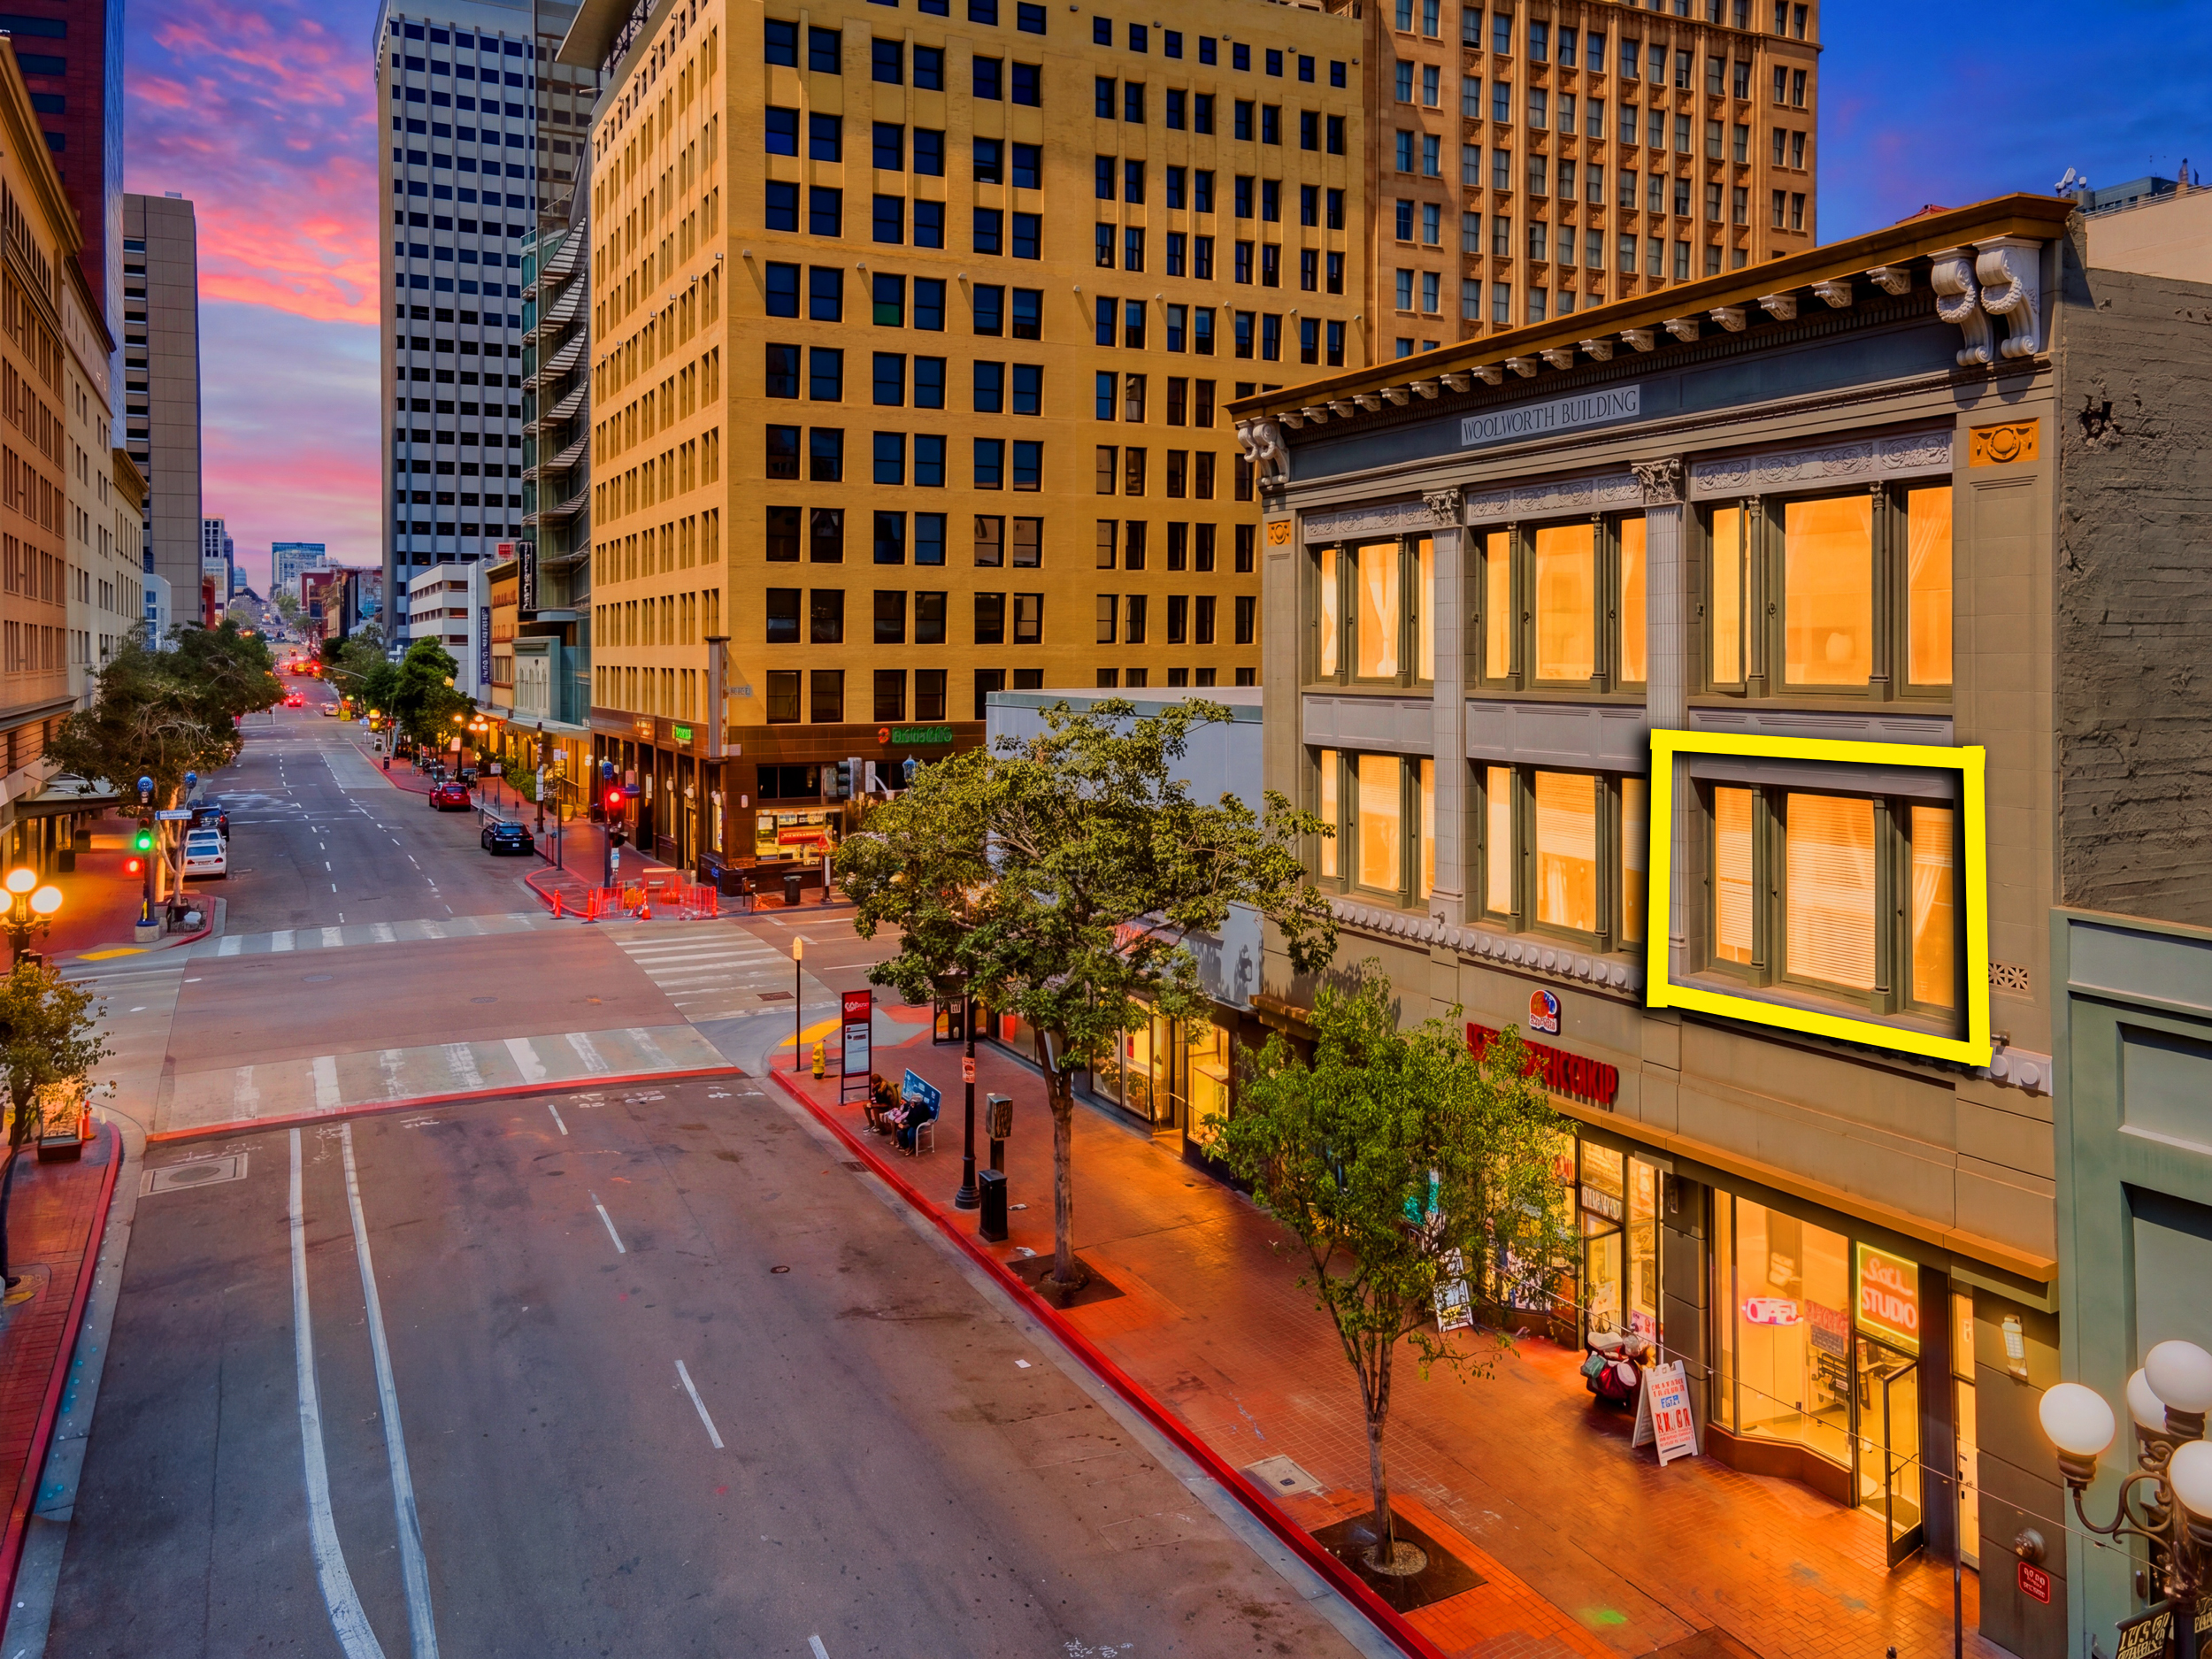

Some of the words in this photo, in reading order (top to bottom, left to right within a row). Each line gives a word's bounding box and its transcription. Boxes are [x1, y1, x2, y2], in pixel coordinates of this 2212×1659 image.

[1463, 404, 1555, 442] WOOLWORTH
[1562, 390, 1637, 425] BUILDING
[1862, 1285, 1917, 1330] STUDIO
